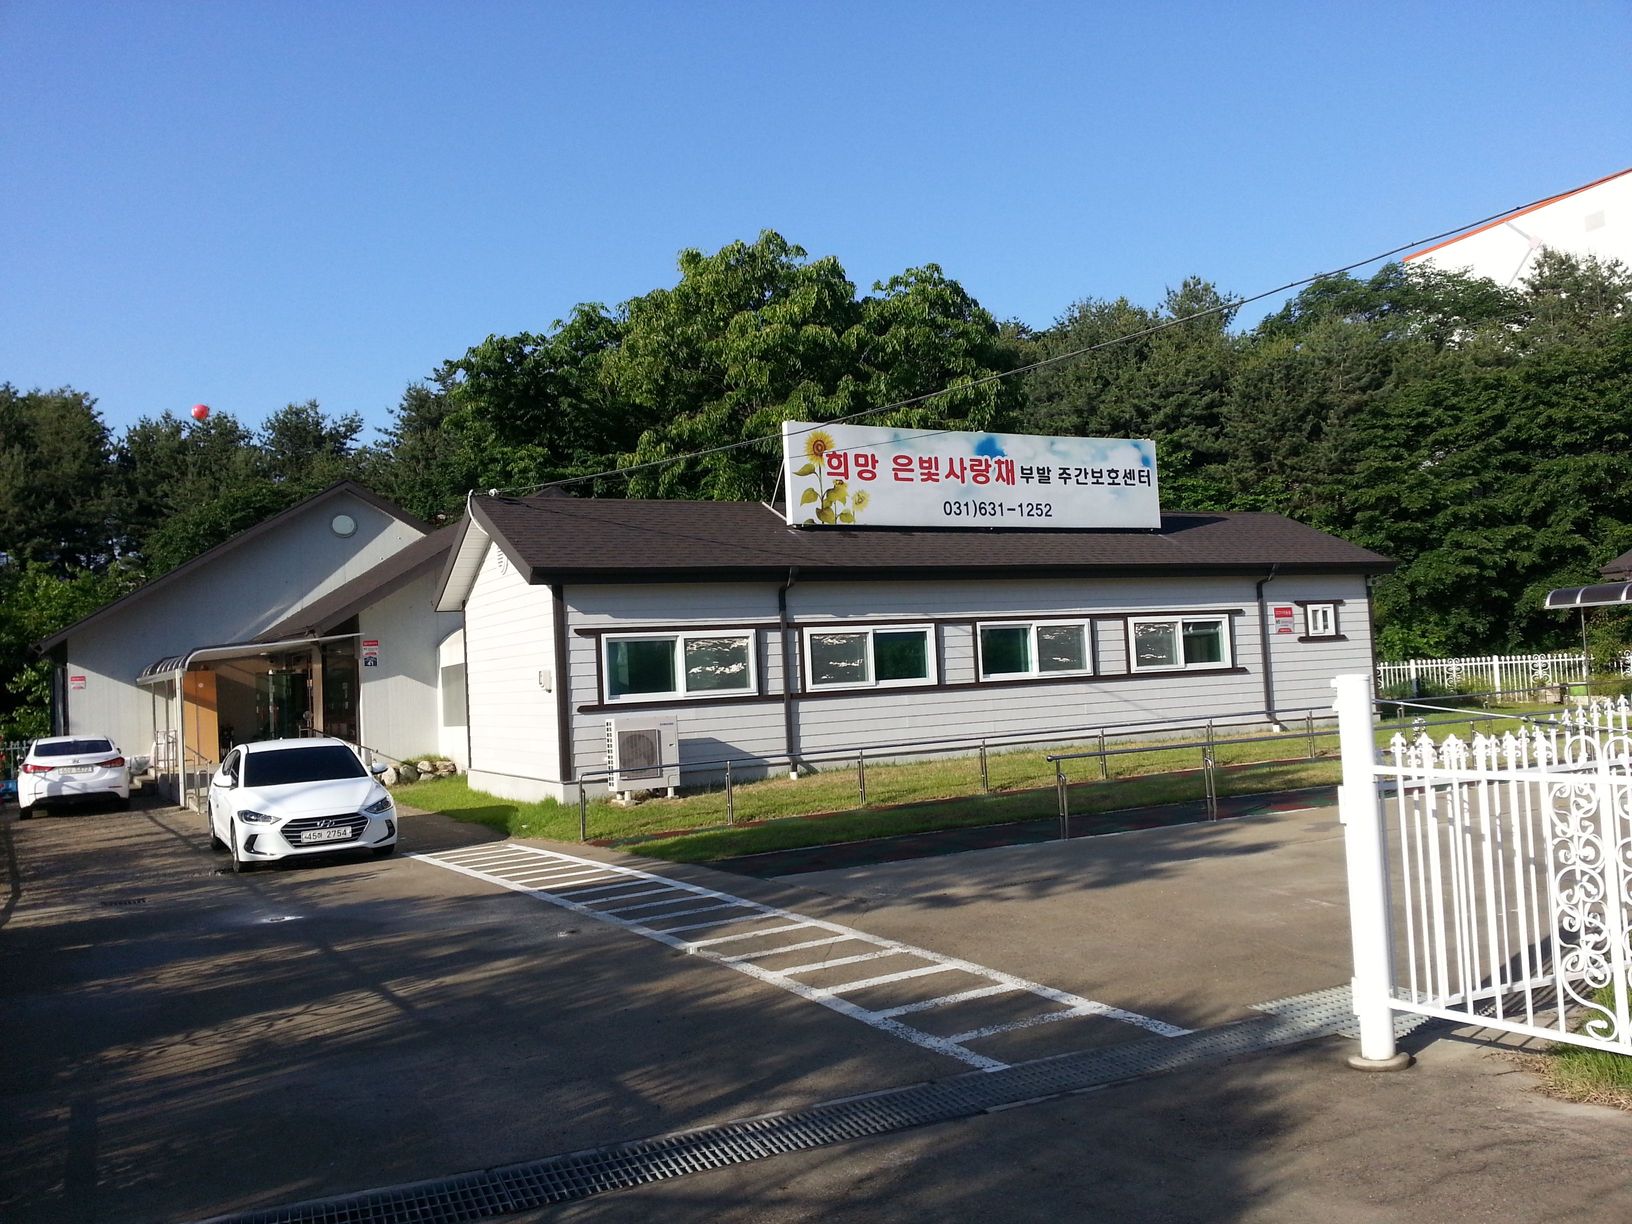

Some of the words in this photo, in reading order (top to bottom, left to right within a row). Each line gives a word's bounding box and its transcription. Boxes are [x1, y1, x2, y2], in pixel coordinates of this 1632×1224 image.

[825, 450, 879, 481] 희망
[1020, 465, 1052, 485] 부발
[1058, 467, 1151, 487] 주간보호센터
[943, 499, 1053, 518] 031)631-1252
[326, 829, 347, 838] 2754
